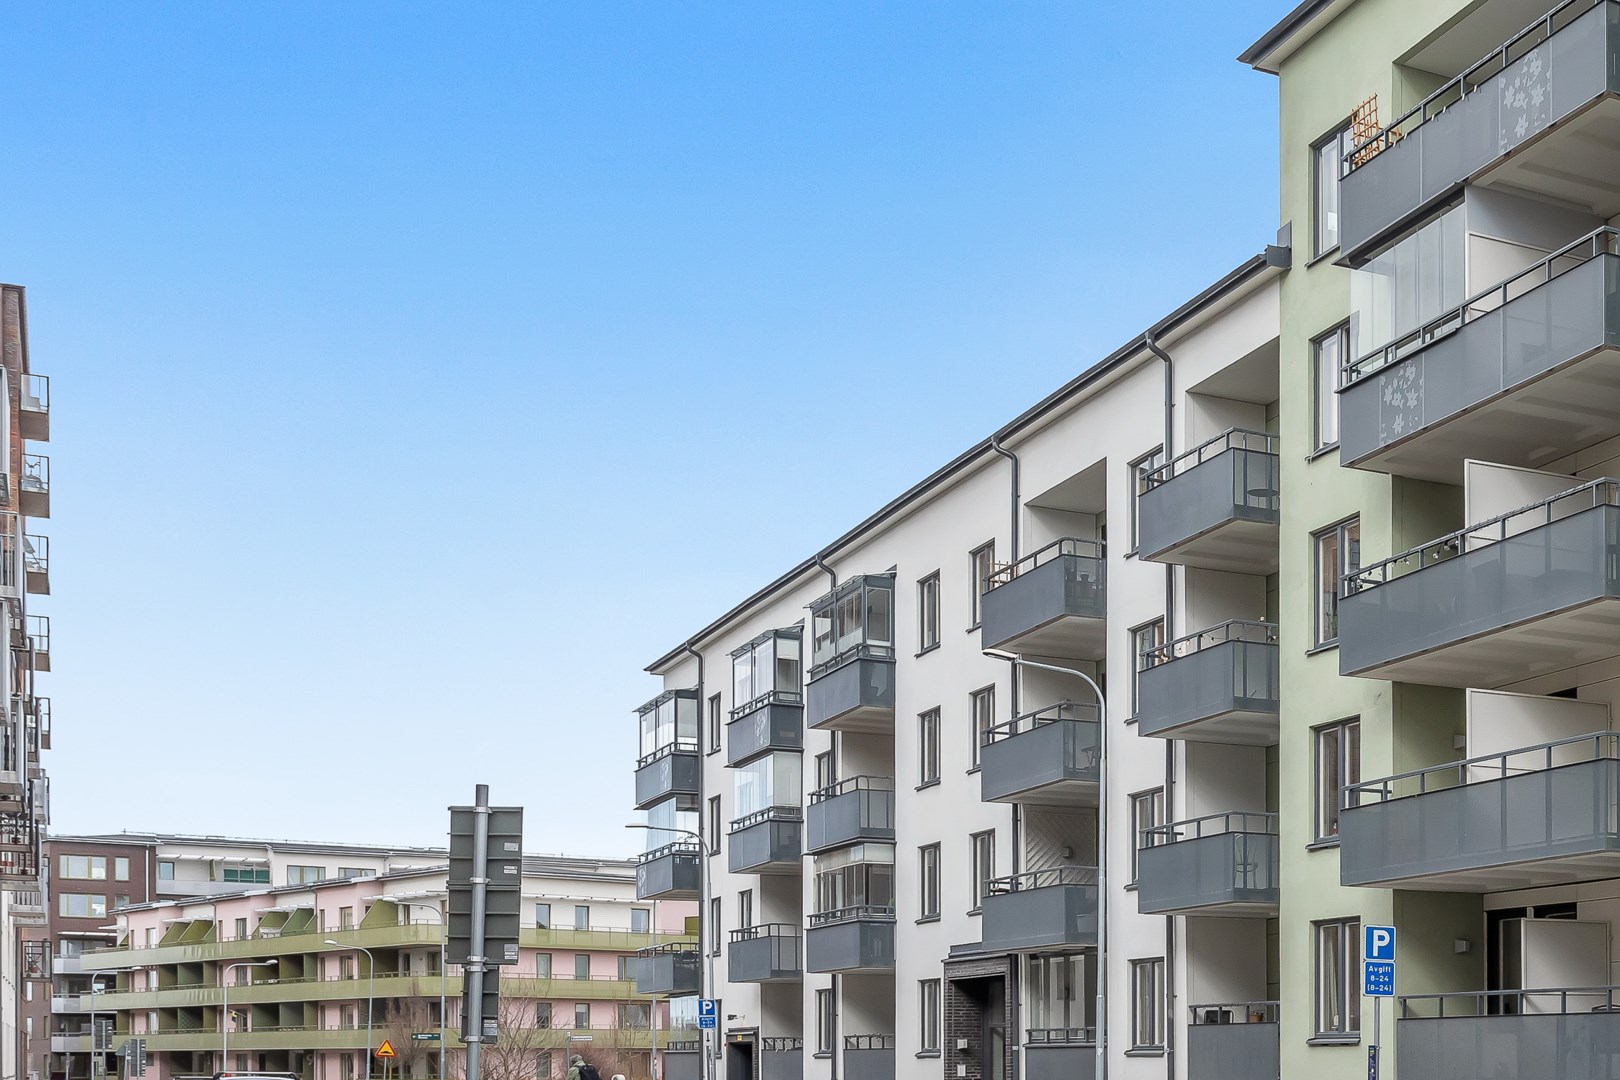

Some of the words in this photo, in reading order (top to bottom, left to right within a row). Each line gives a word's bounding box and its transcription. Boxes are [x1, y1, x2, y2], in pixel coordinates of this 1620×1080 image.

[1372, 929, 1391, 957] P
[1368, 965, 1391, 974] Avgift
[1367, 984, 1392, 992] (8-24)
[702, 1001, 713, 1015] P
